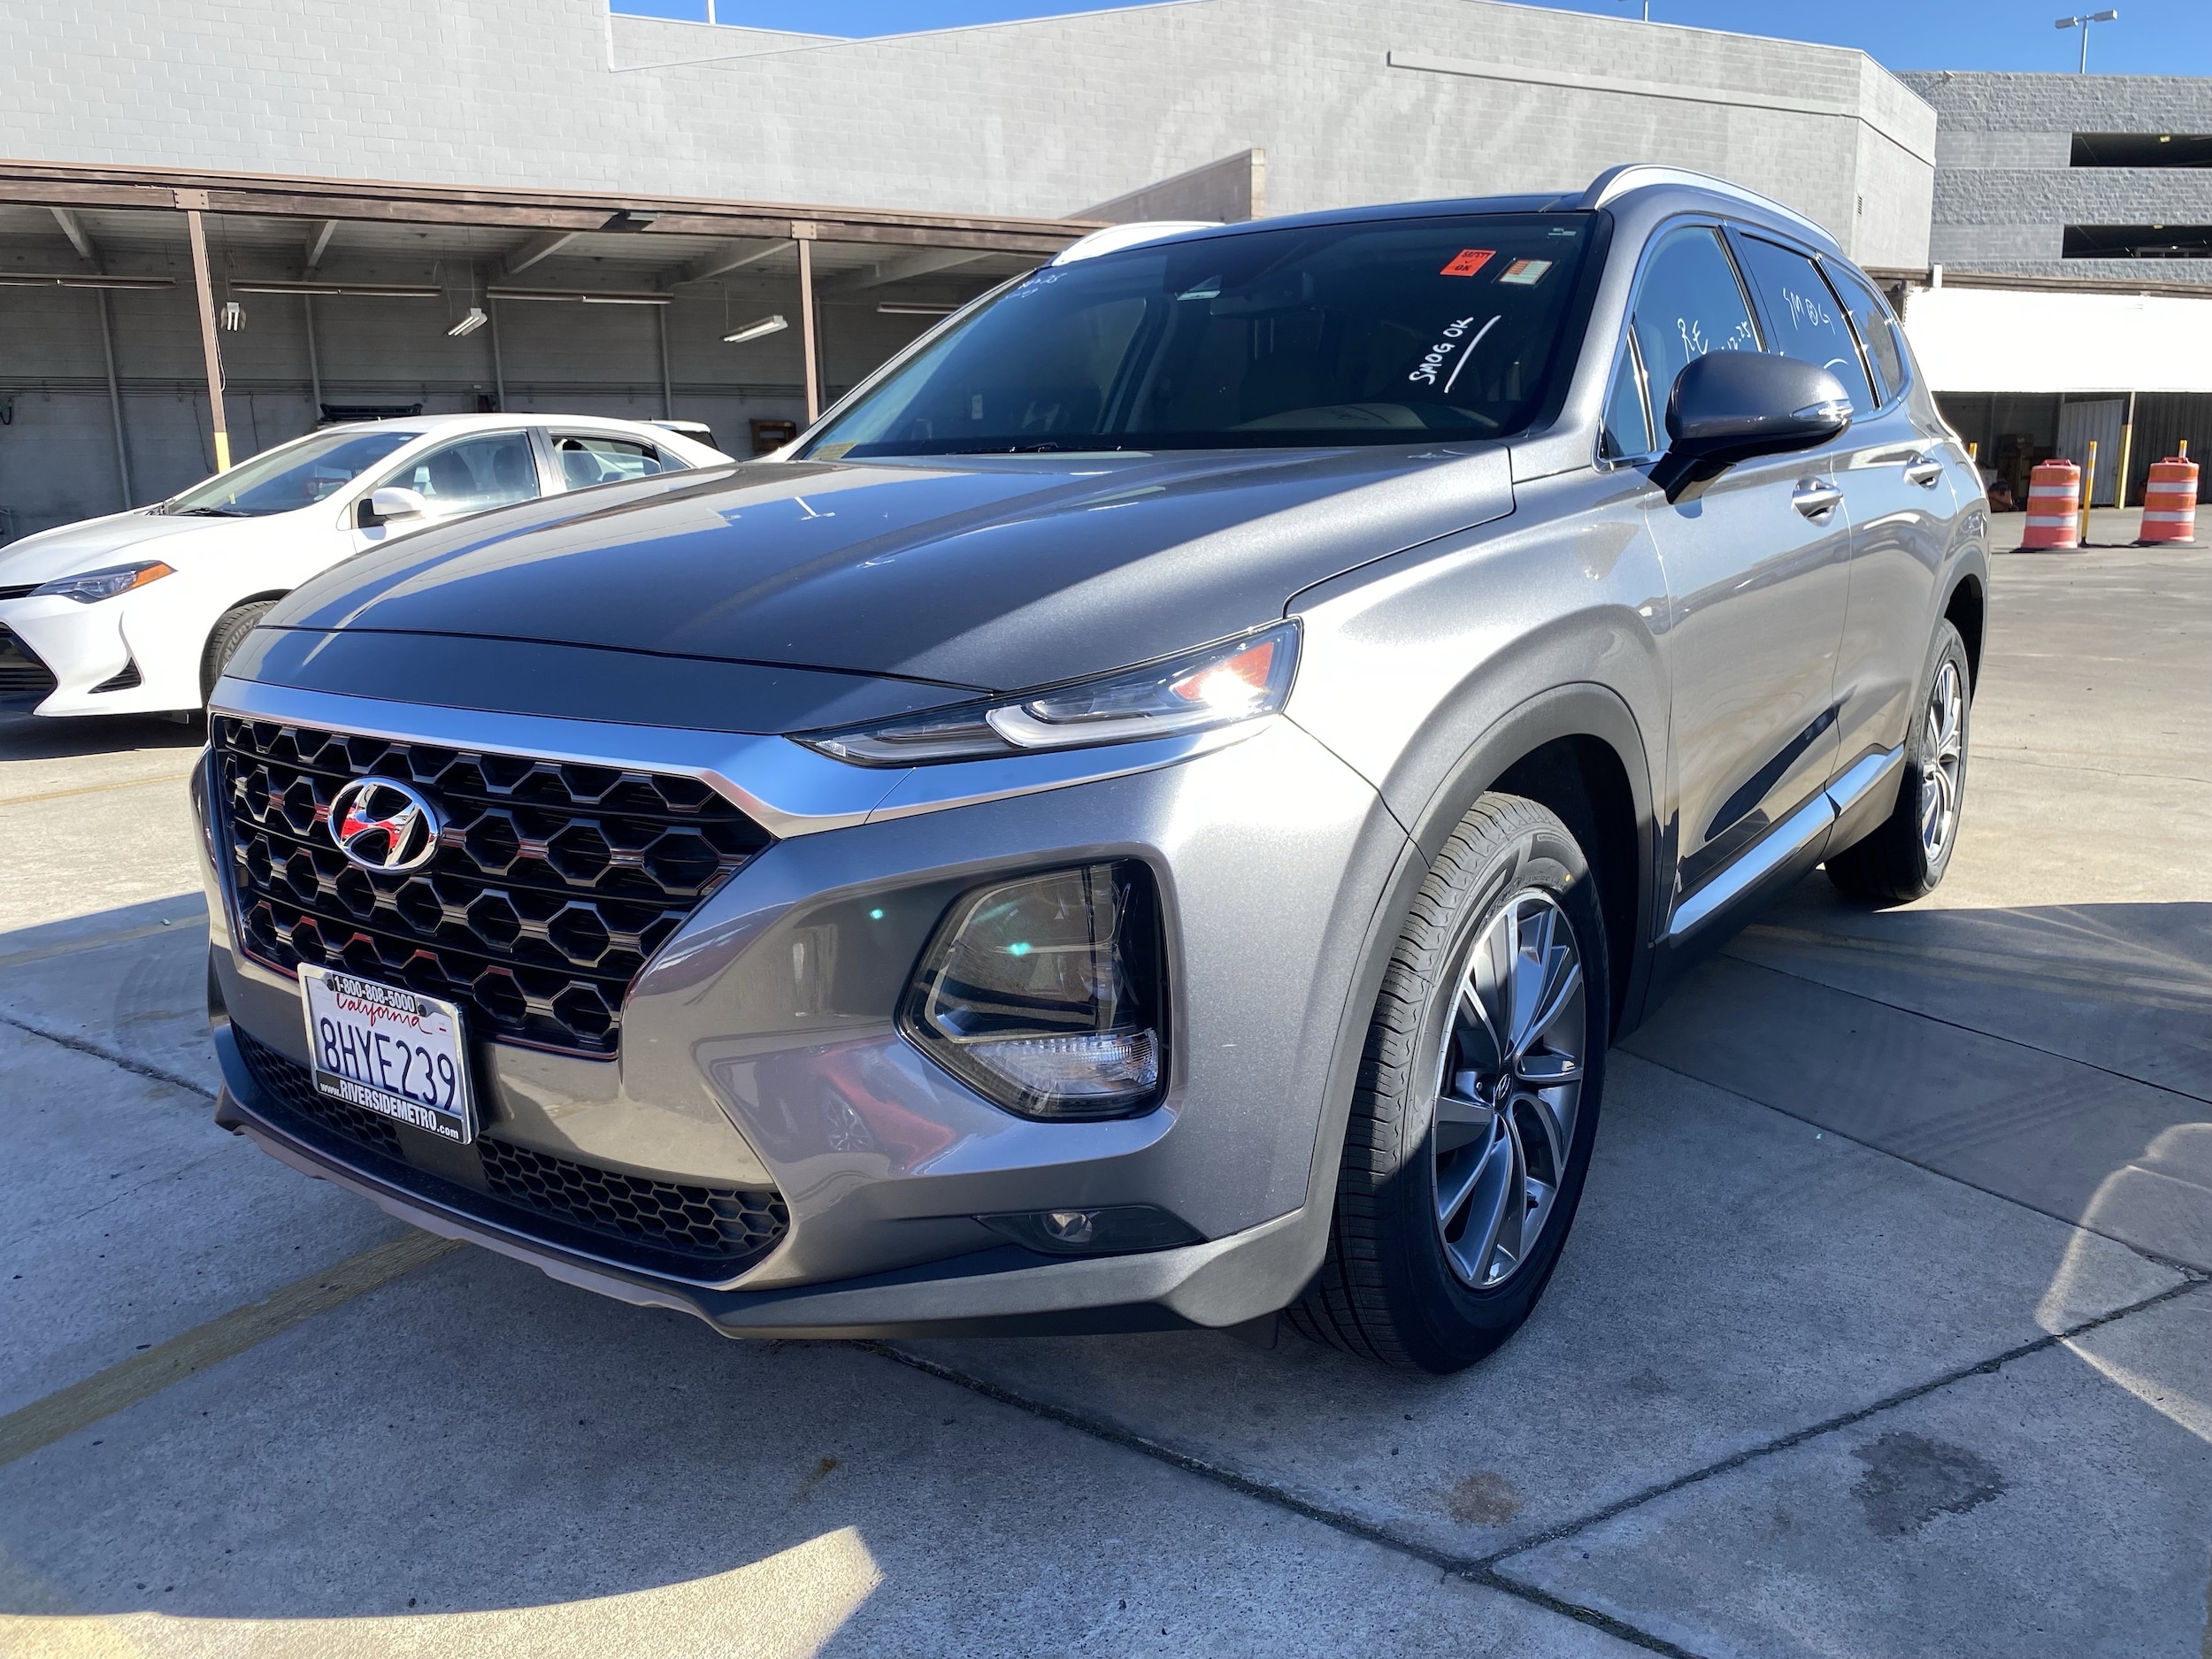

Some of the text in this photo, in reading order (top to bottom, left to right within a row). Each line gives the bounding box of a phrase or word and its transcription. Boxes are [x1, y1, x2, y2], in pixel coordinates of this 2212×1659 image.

[1409, 316, 1474, 386] SMOG OK
[334, 975, 416, 1014] 1-800-808-5000
[335, 992, 433, 1035] California
[319, 1017, 457, 1111] 8HYE239
[319, 1079, 459, 1141] www.RIVERSIDEMETRO.com
